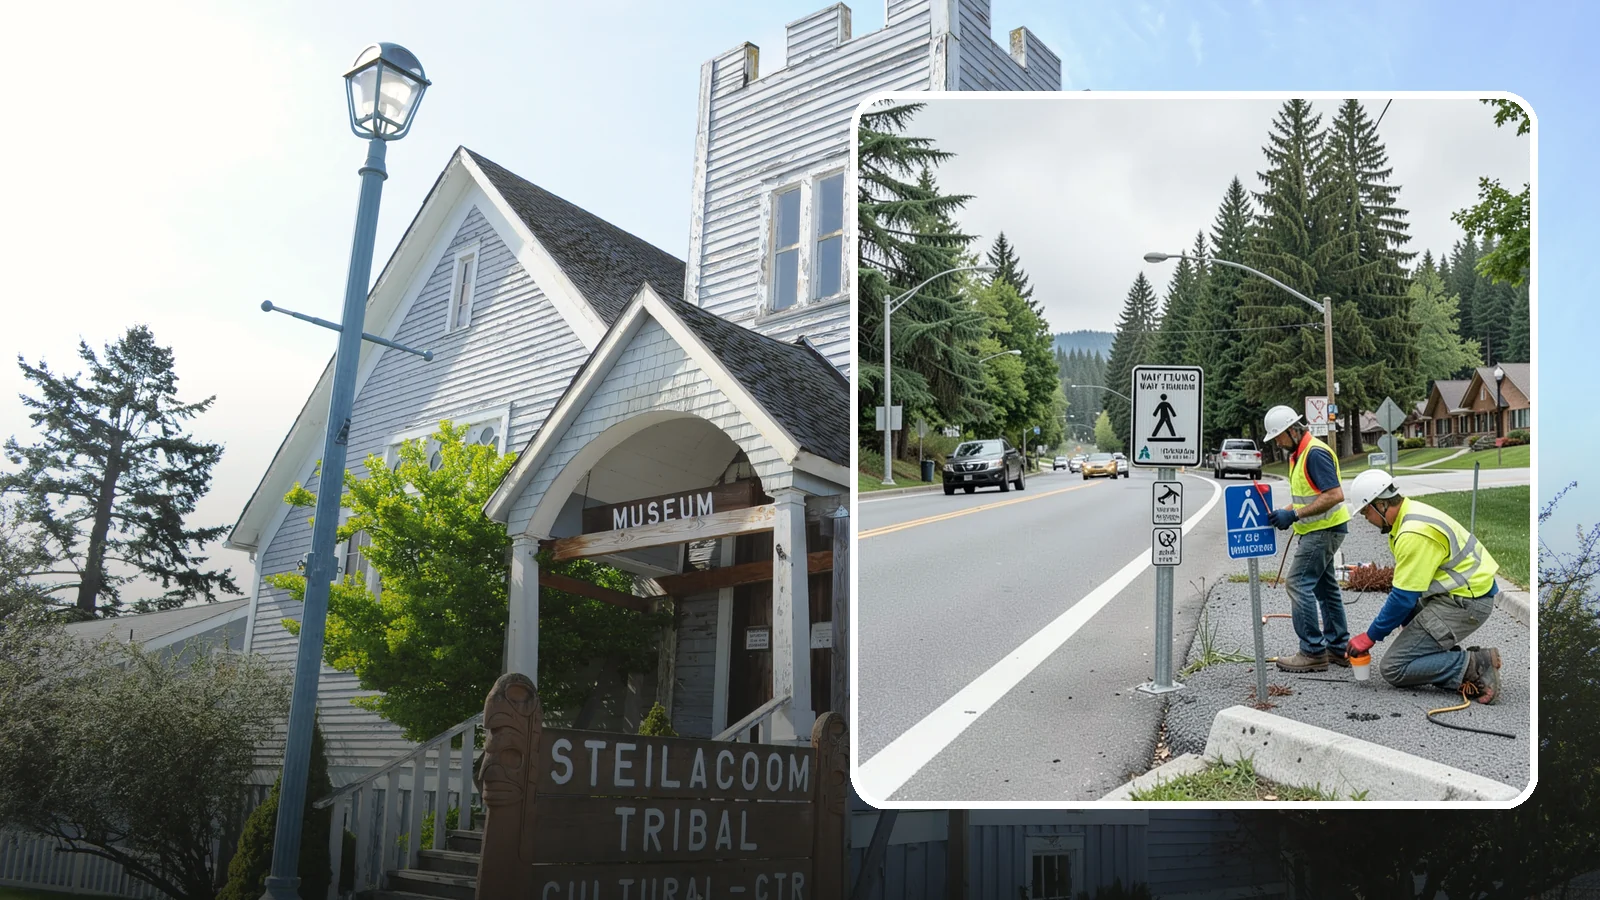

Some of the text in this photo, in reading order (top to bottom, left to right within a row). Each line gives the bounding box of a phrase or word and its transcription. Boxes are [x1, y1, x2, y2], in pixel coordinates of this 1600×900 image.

[613, 491, 713, 531] MUSEUM
[550, 738, 809, 793] STEILACOOM
[615, 806, 757, 852] TRIBAL
